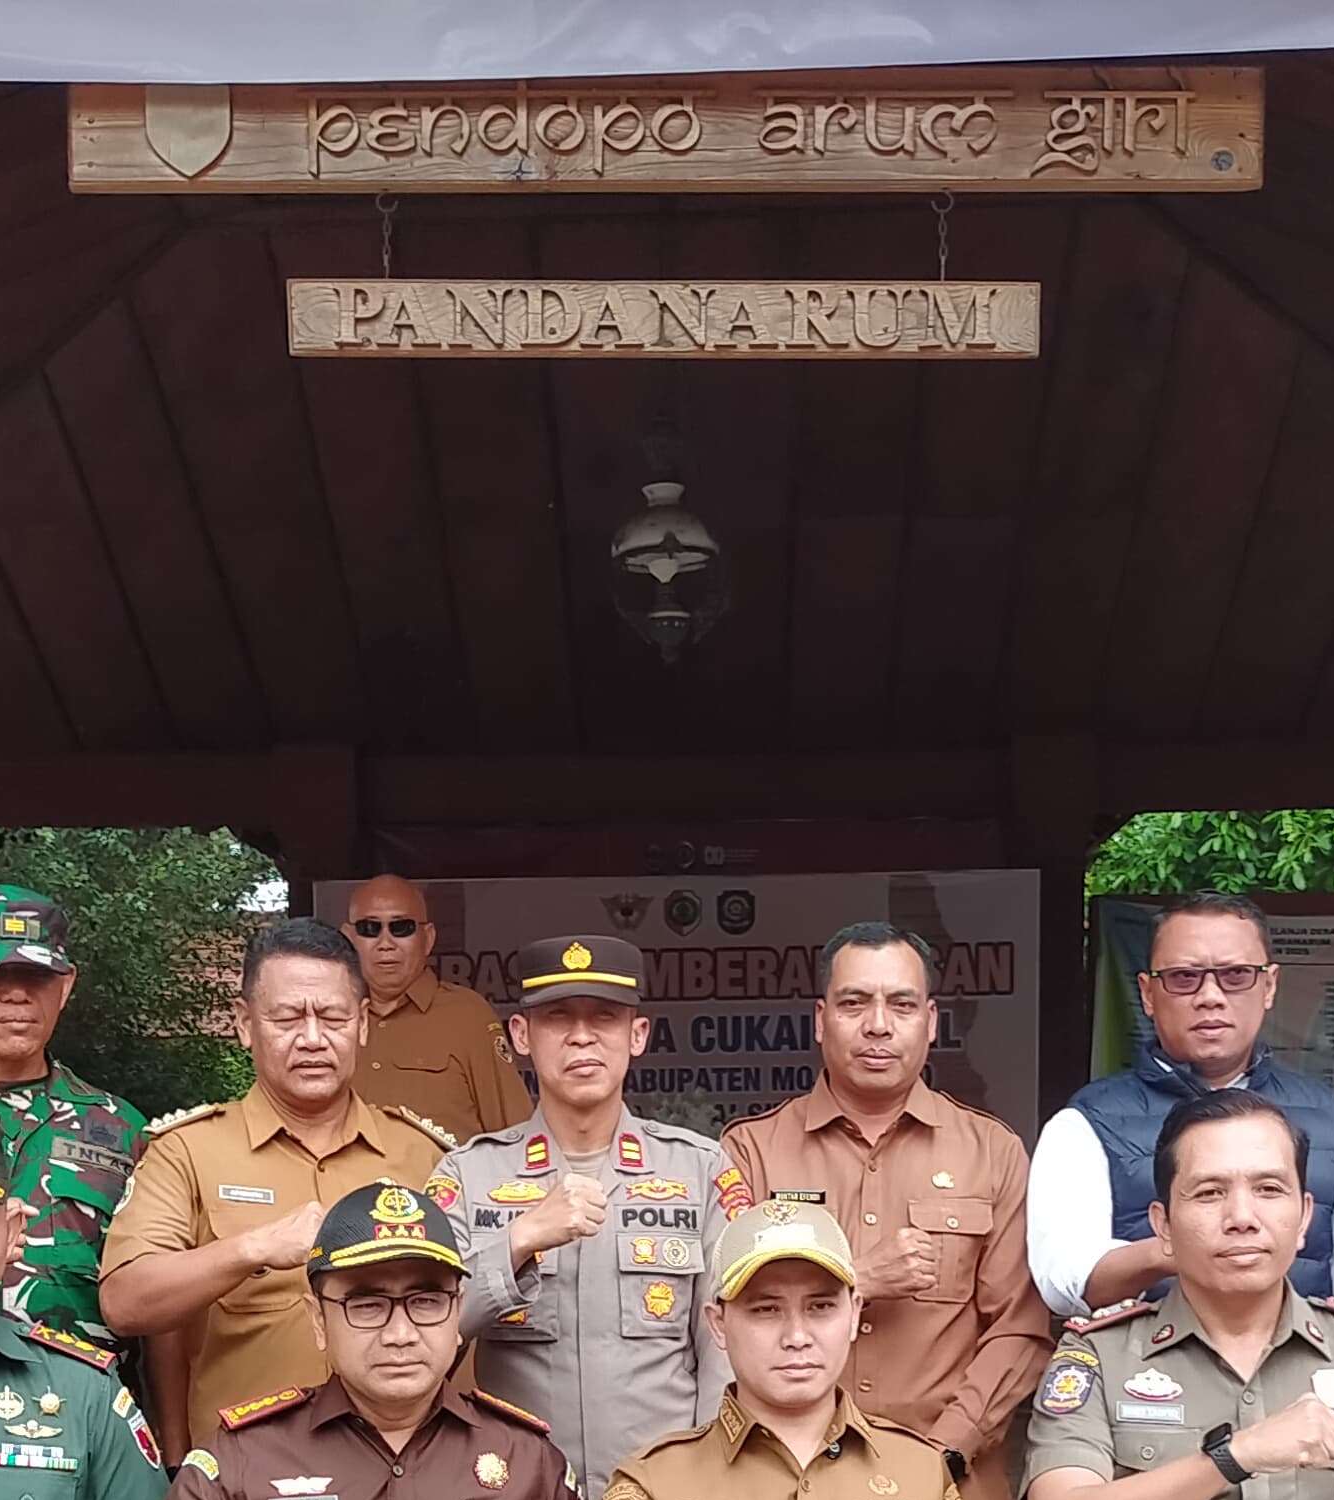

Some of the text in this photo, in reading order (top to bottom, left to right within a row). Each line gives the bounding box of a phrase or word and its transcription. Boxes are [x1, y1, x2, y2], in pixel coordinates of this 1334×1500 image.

[305, 90, 704, 177] pendopo
[757, 93, 999, 157] arum
[332, 286, 998, 350] PANDANARUM
[691, 1015, 811, 1053] CUKAI
[63, 1142, 101, 1164] TNI
[621, 1207, 698, 1230] POLRI
